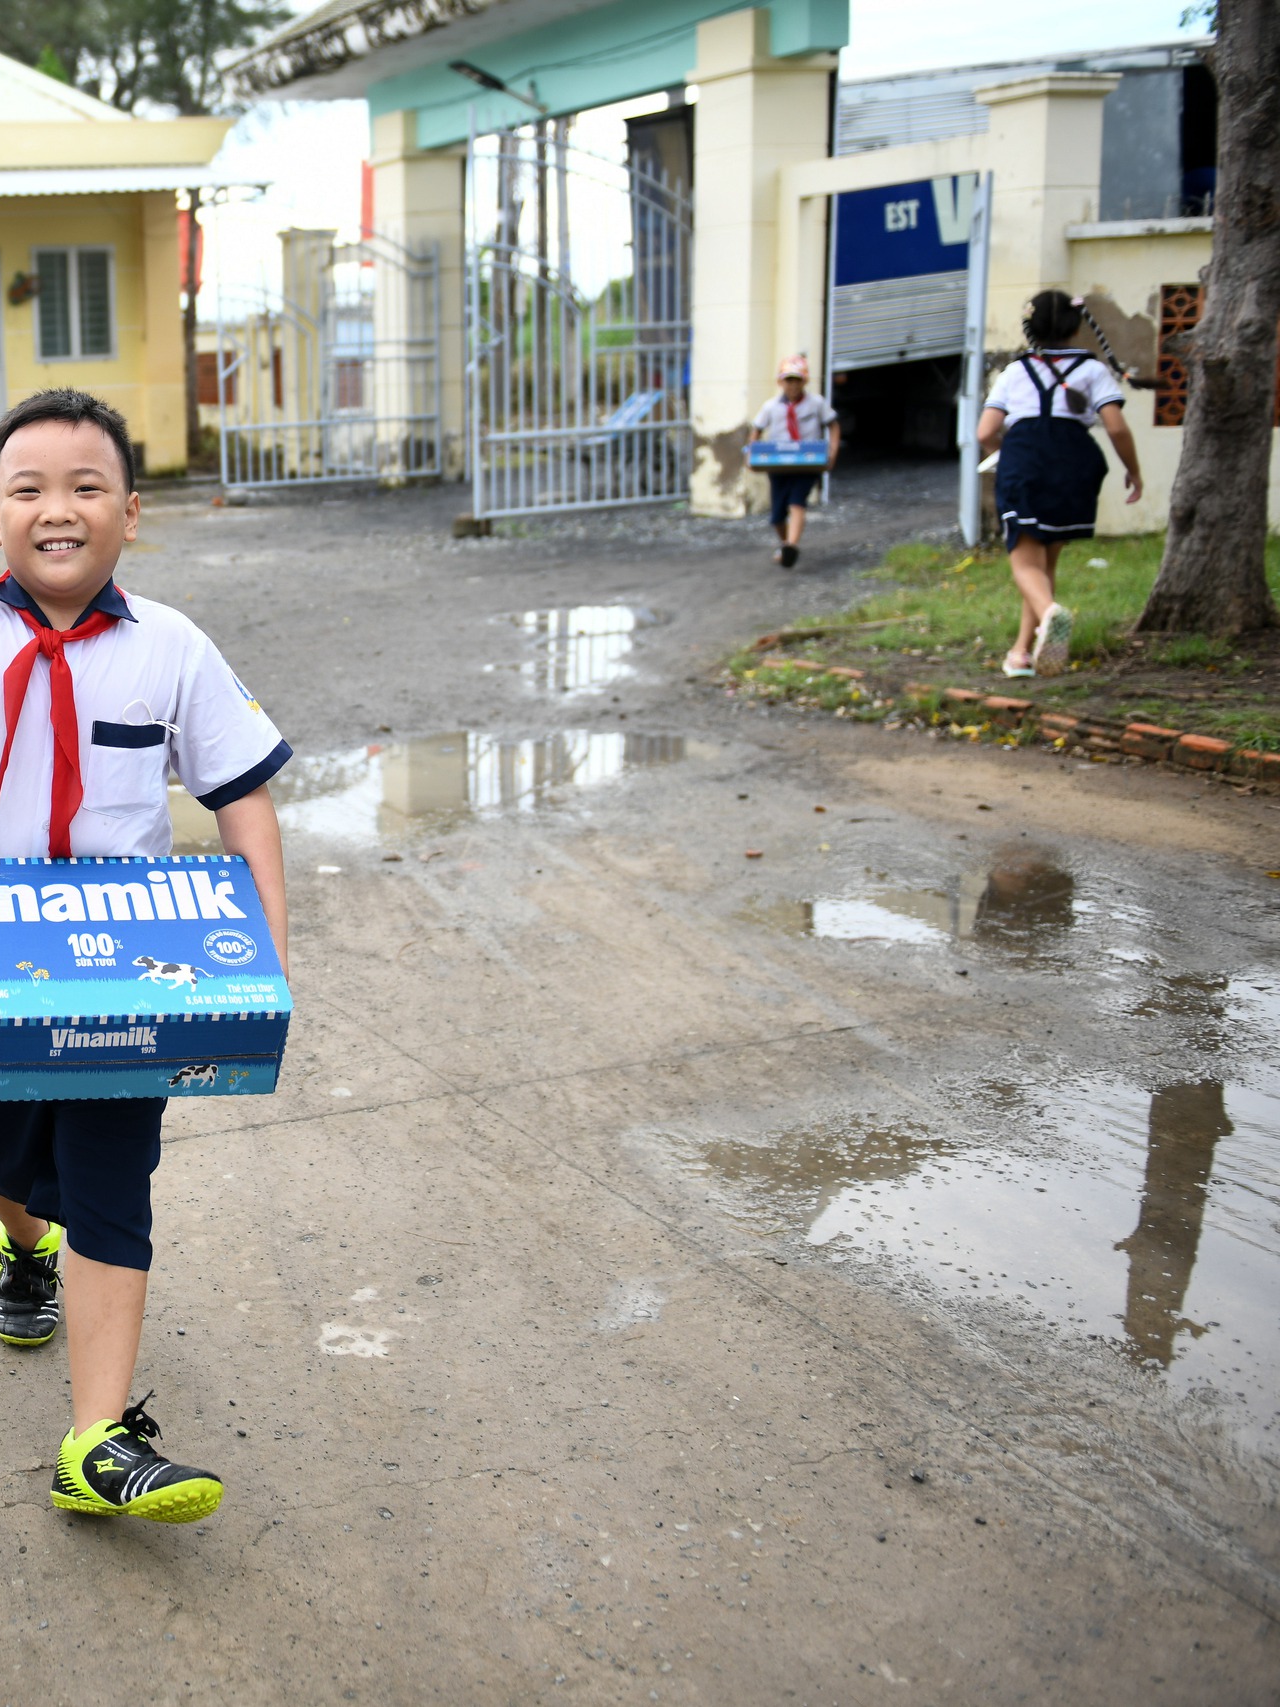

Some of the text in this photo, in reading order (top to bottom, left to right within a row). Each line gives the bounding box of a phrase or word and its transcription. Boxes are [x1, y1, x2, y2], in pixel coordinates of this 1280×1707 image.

[885, 199, 920, 232] EST
[49, 1046, 157, 1057] EST 1976
